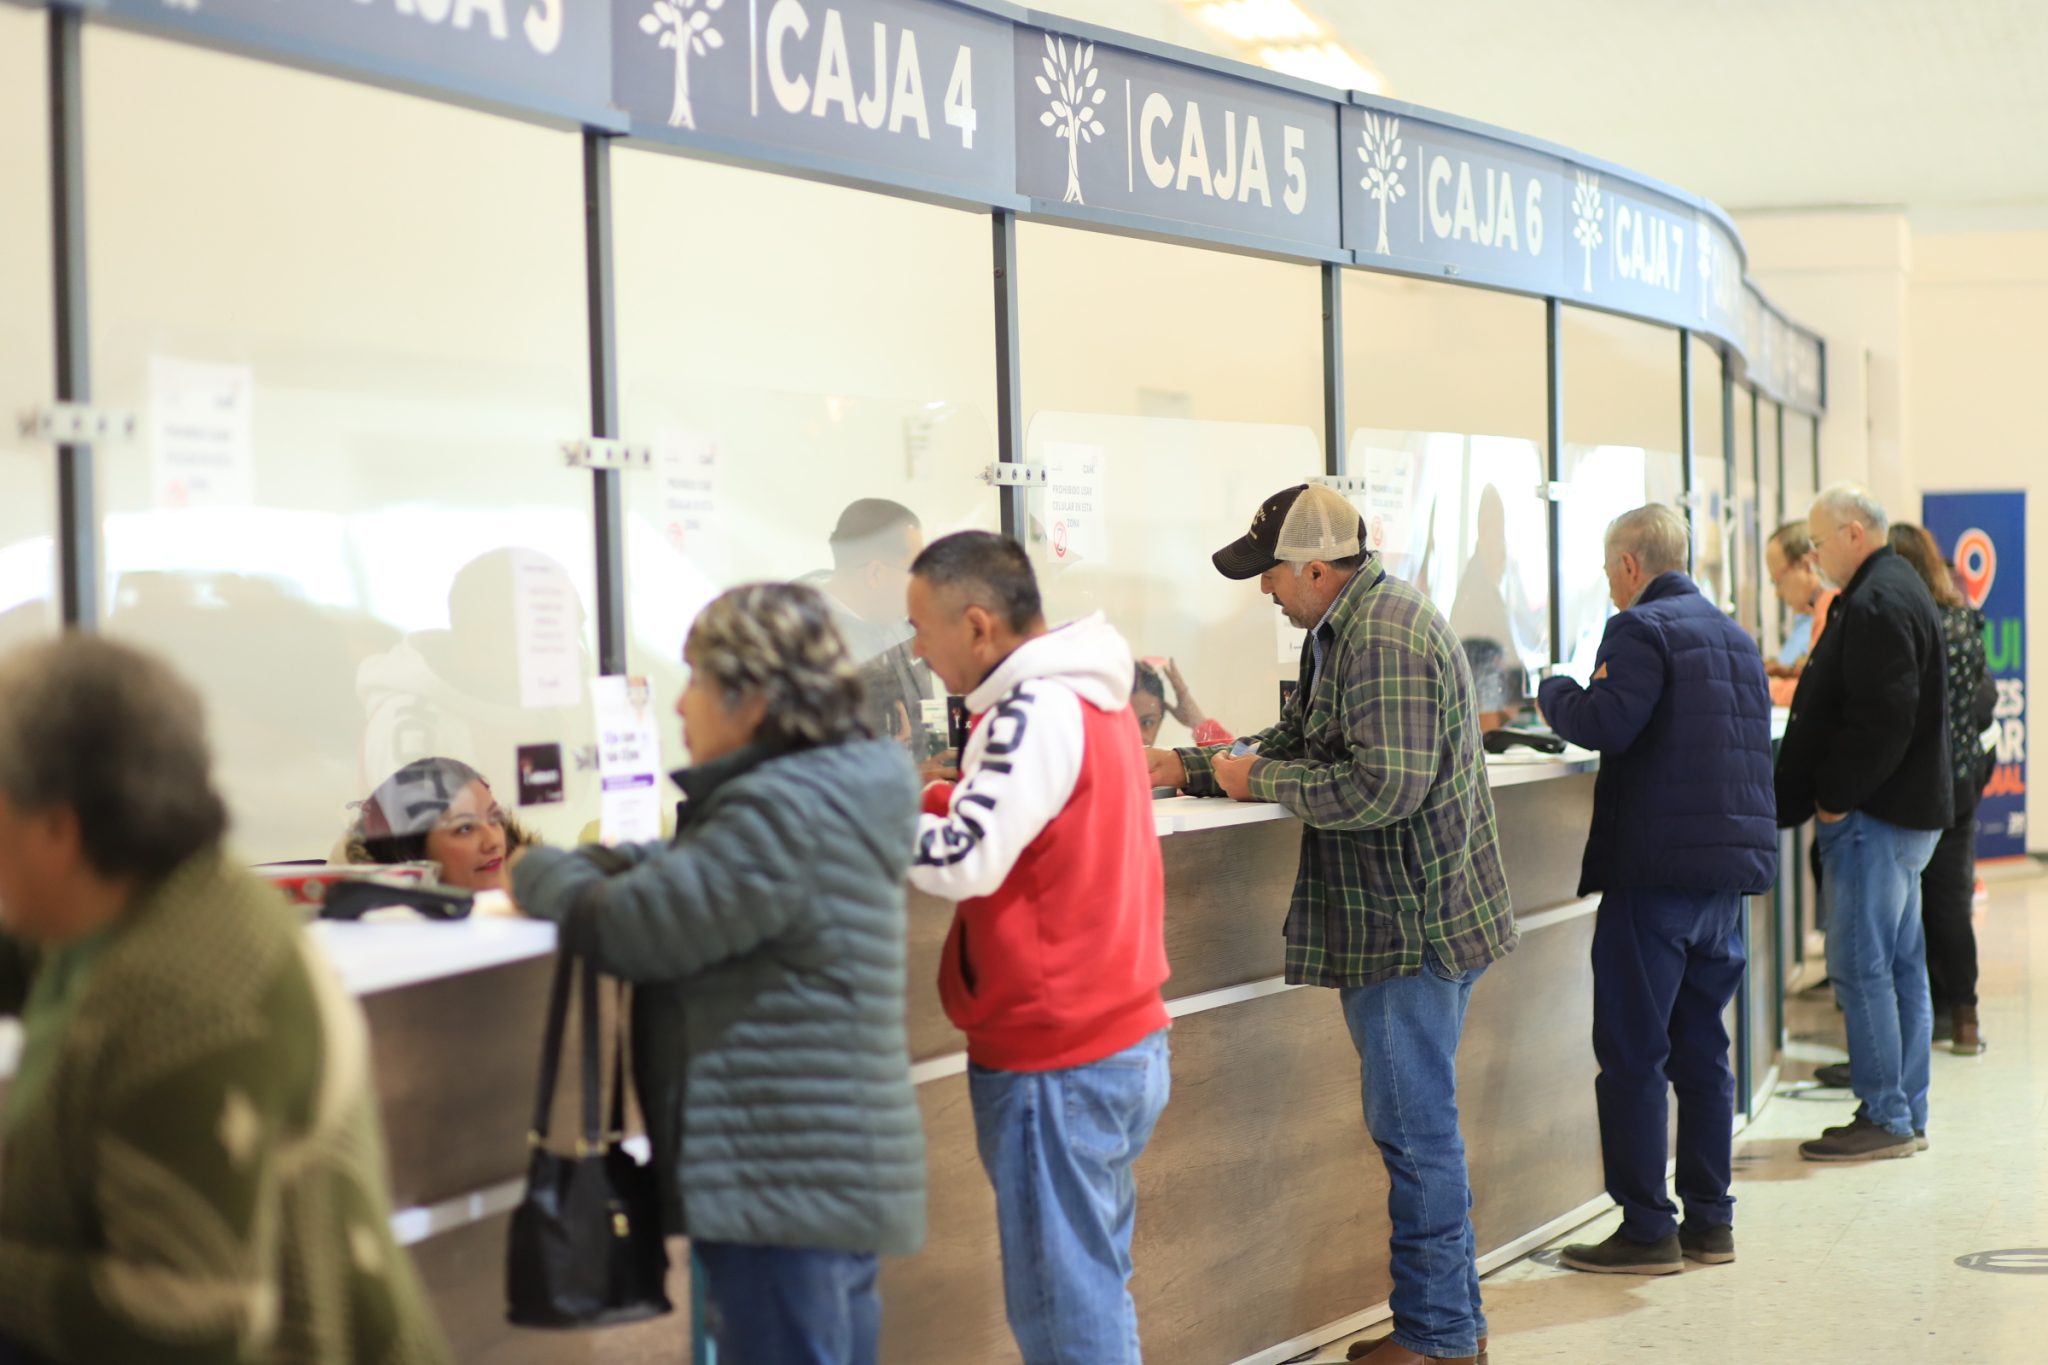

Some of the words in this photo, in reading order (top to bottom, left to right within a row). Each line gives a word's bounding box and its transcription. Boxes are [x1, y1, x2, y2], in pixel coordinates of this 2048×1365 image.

[766, 0, 930, 140] CAJA
[944, 45, 976, 149] 4
[1140, 92, 1272, 207] CAJA
[1283, 125, 1307, 215] 5
[1428, 155, 1519, 252] CAJA
[1525, 178, 1544, 256] 6
[1615, 204, 1671, 291] CAJA
[1672, 224, 1684, 294] 7
